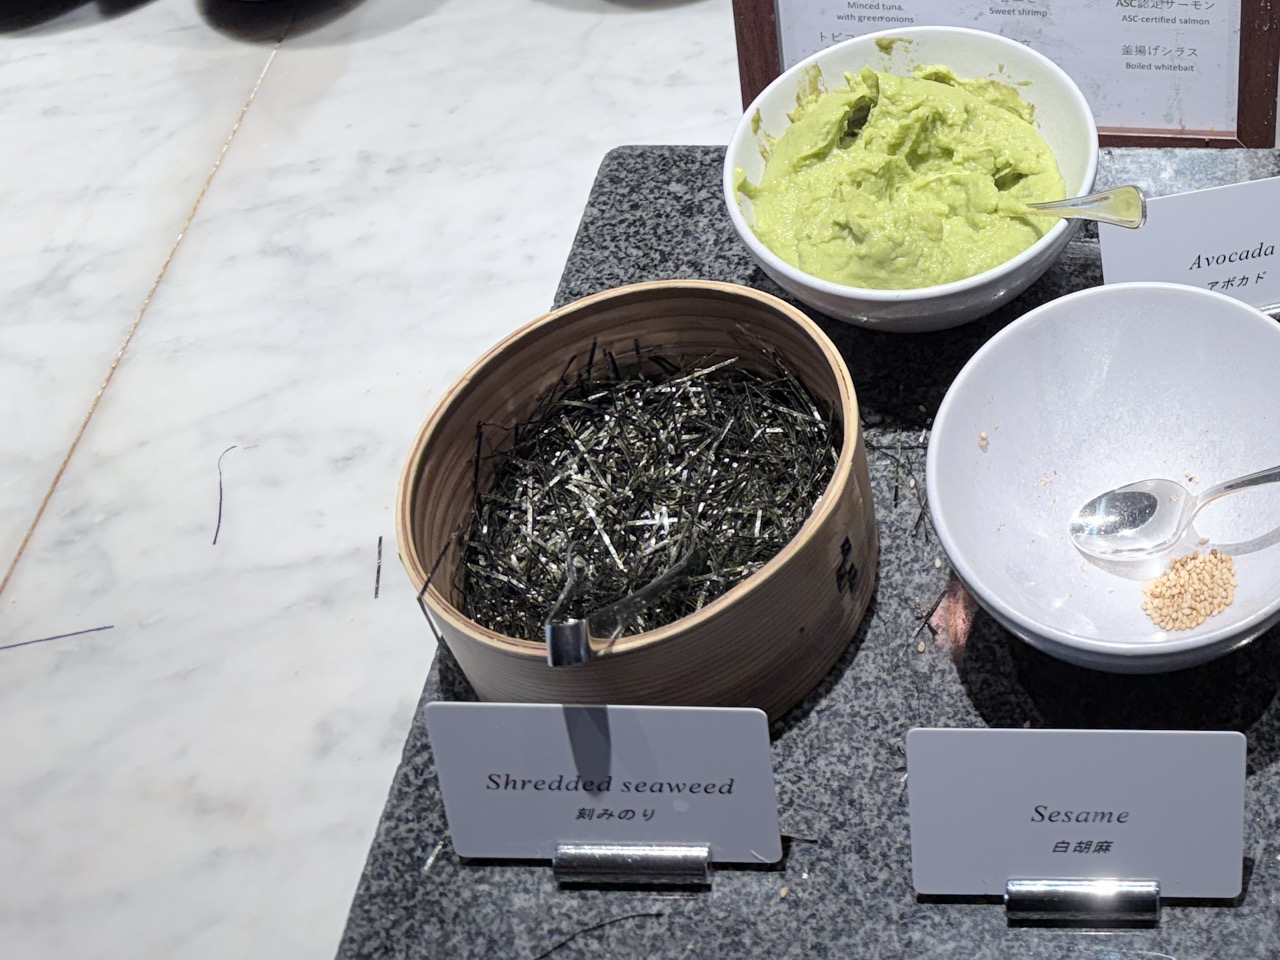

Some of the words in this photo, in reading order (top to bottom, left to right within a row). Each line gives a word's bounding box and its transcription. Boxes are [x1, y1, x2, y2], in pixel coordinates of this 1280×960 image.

[847, 1, 880, 10] Minced
[989, 6, 1016, 15] Sweet
[1018, 8, 1048, 18] shrimp
[836, 13, 856, 21] with
[858, 15, 883, 23] green
[884, 15, 915, 24] onions
[1121, 14, 1177, 24] ASC-certified
[1179, 17, 1210, 25] salmon
[1121, 44, 1198, 57] 釜揚げシラス
[1125, 62, 1152, 70] Boiled
[1154, 63, 1194, 72] whitebait
[1189, 242, 1276, 271] Avocada
[486, 773, 613, 792] Shredded
[621, 777, 735, 796] seaweed
[576, 807, 655, 822] 刻みのり
[1031, 805, 1130, 824] Sesame
[1052, 840, 1114, 854] 白胡麻
